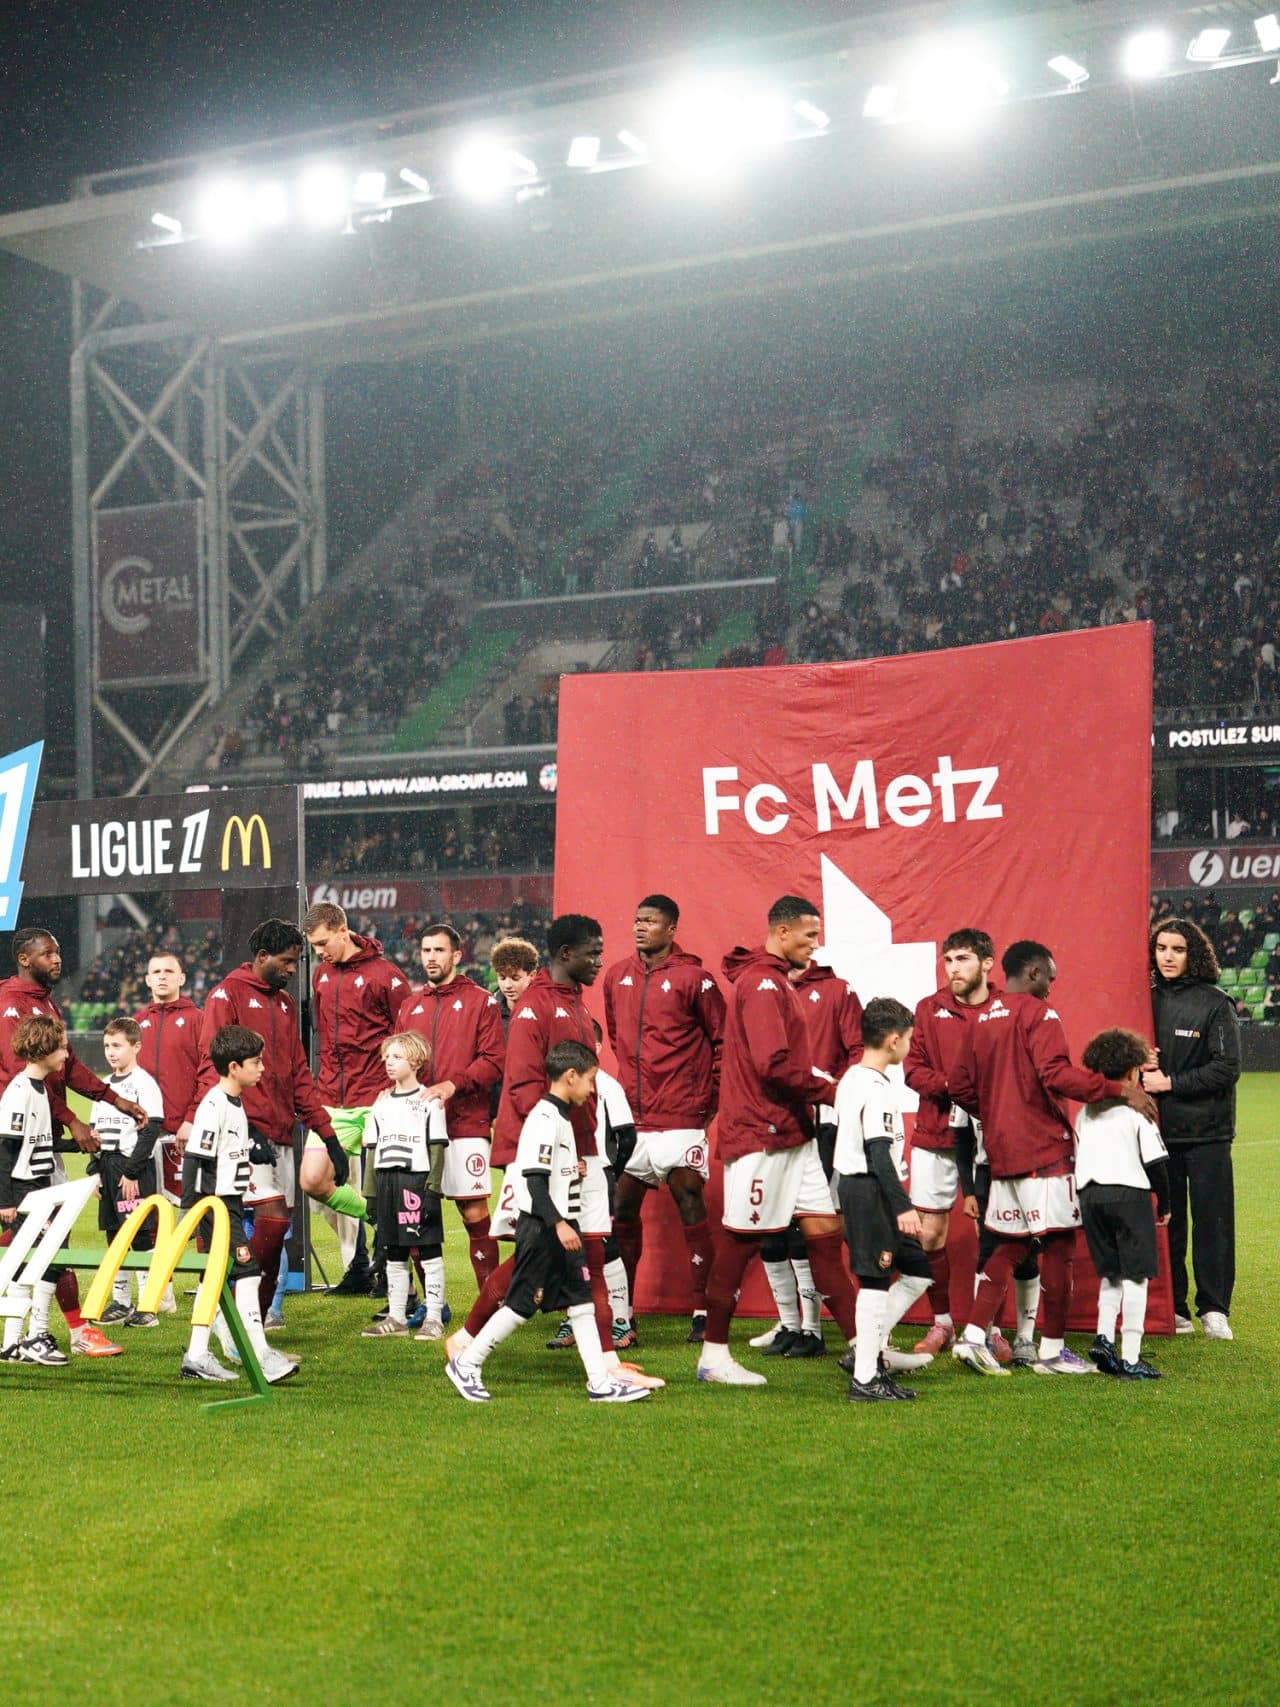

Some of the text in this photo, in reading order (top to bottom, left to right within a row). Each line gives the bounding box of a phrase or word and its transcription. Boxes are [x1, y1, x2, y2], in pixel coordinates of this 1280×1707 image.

[1169, 726, 1248, 748] POSTULEZ
[702, 755, 1003, 835] Fc Metz
[71, 818, 174, 878] LIGUE
[343, 886, 397, 909] uem
[500, 1184, 515, 1211] 2
[749, 1179, 764, 1206] 5
[397, 1210, 421, 1225] BW
